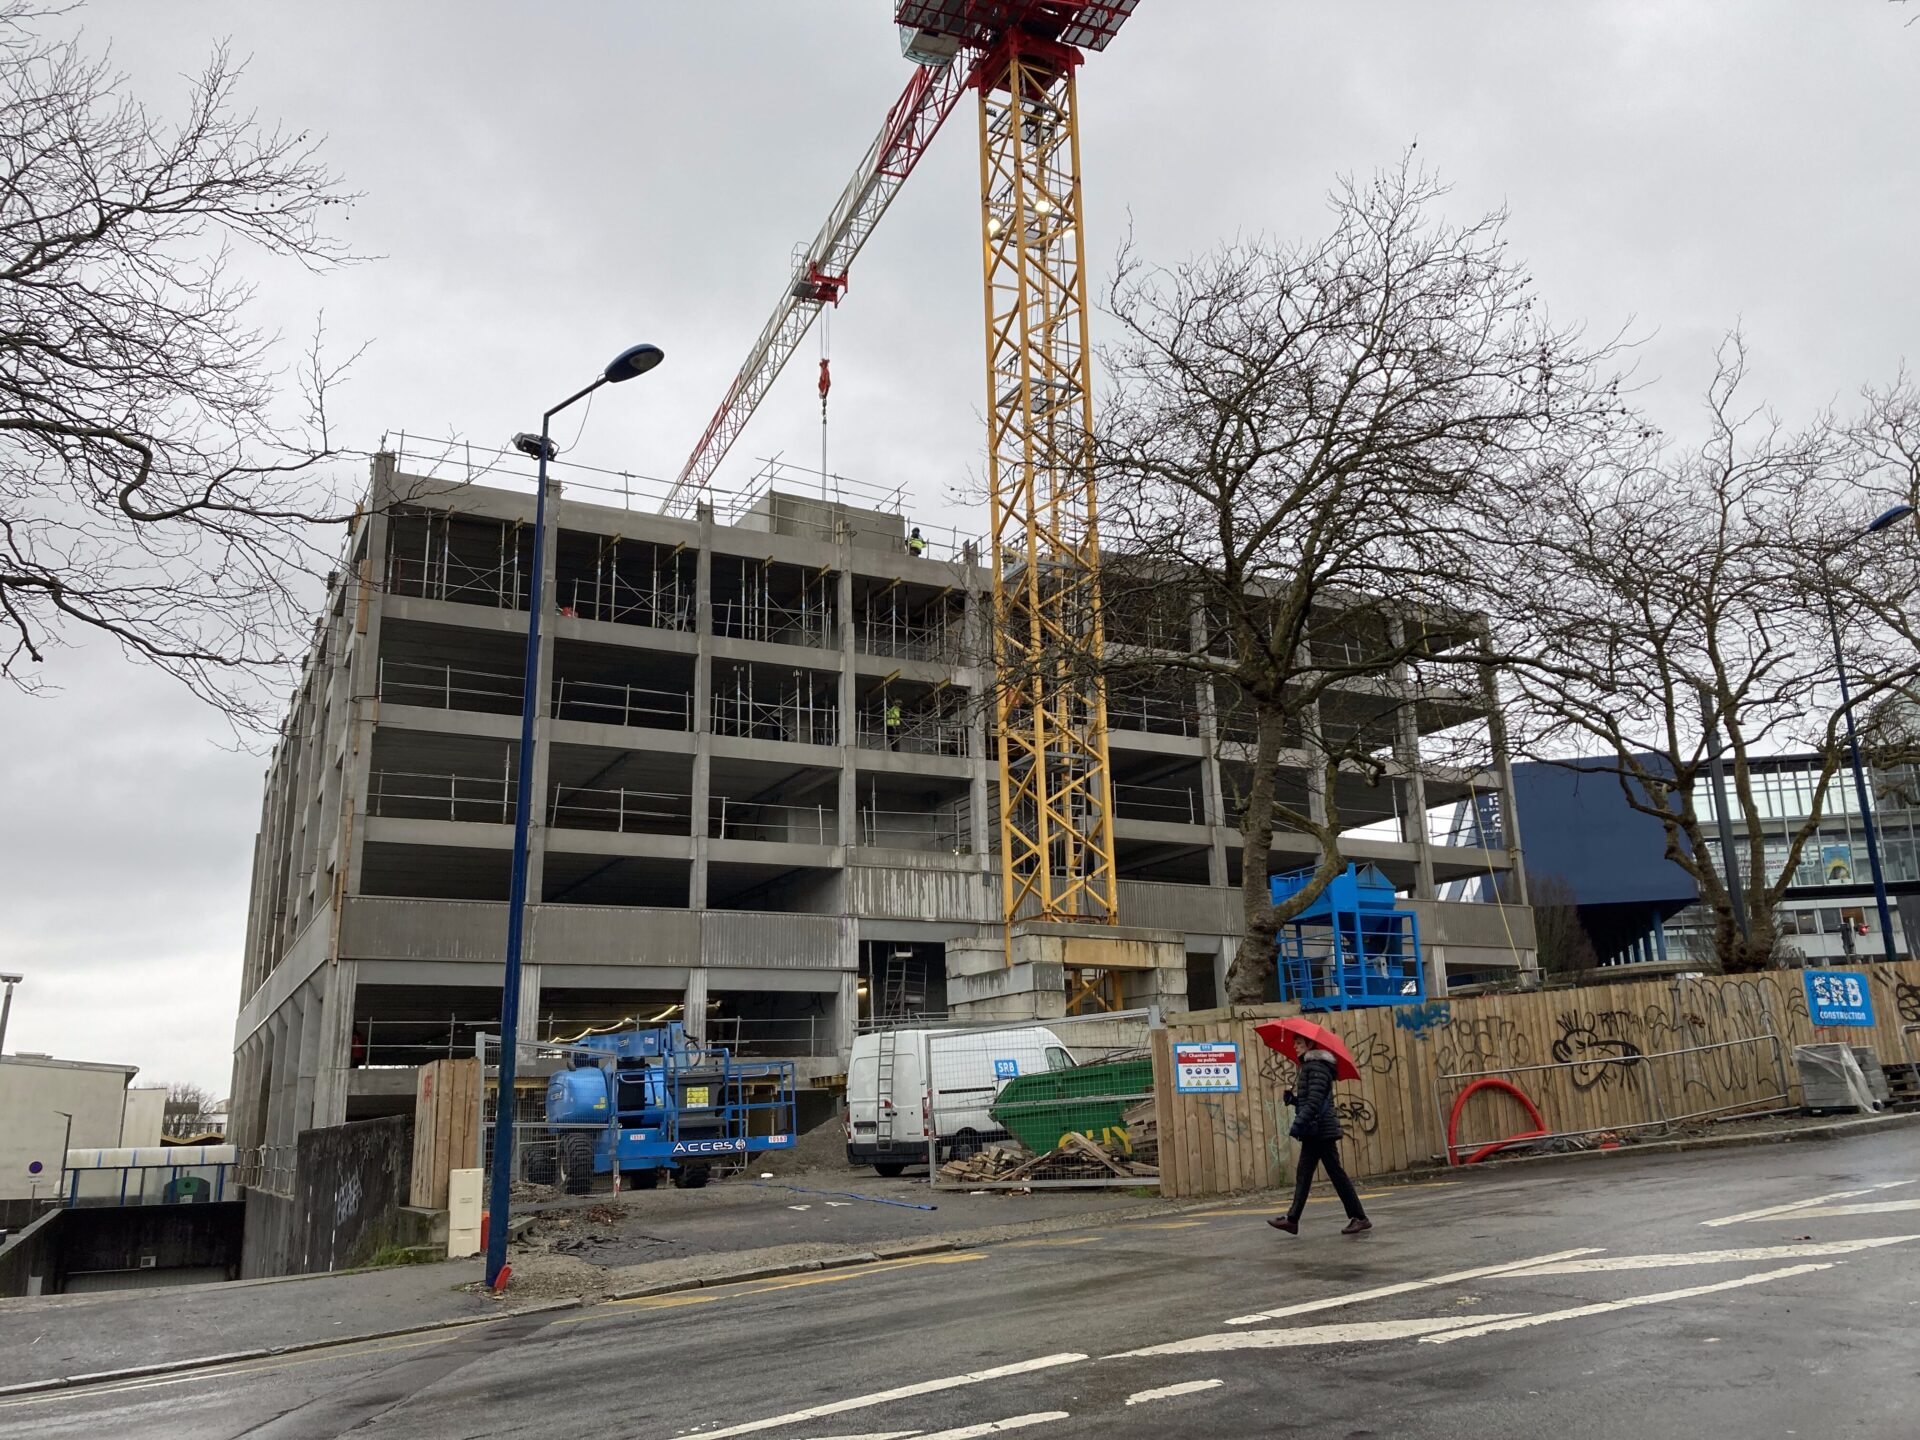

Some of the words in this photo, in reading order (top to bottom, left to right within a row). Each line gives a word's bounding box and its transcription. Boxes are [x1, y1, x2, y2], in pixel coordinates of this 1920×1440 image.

[1814, 976, 1863, 1007] SRB
[1819, 1011, 1866, 1020] CONSTRUCTION
[998, 1062, 1014, 1072] SRB
[672, 1141, 733, 1153] Acces
